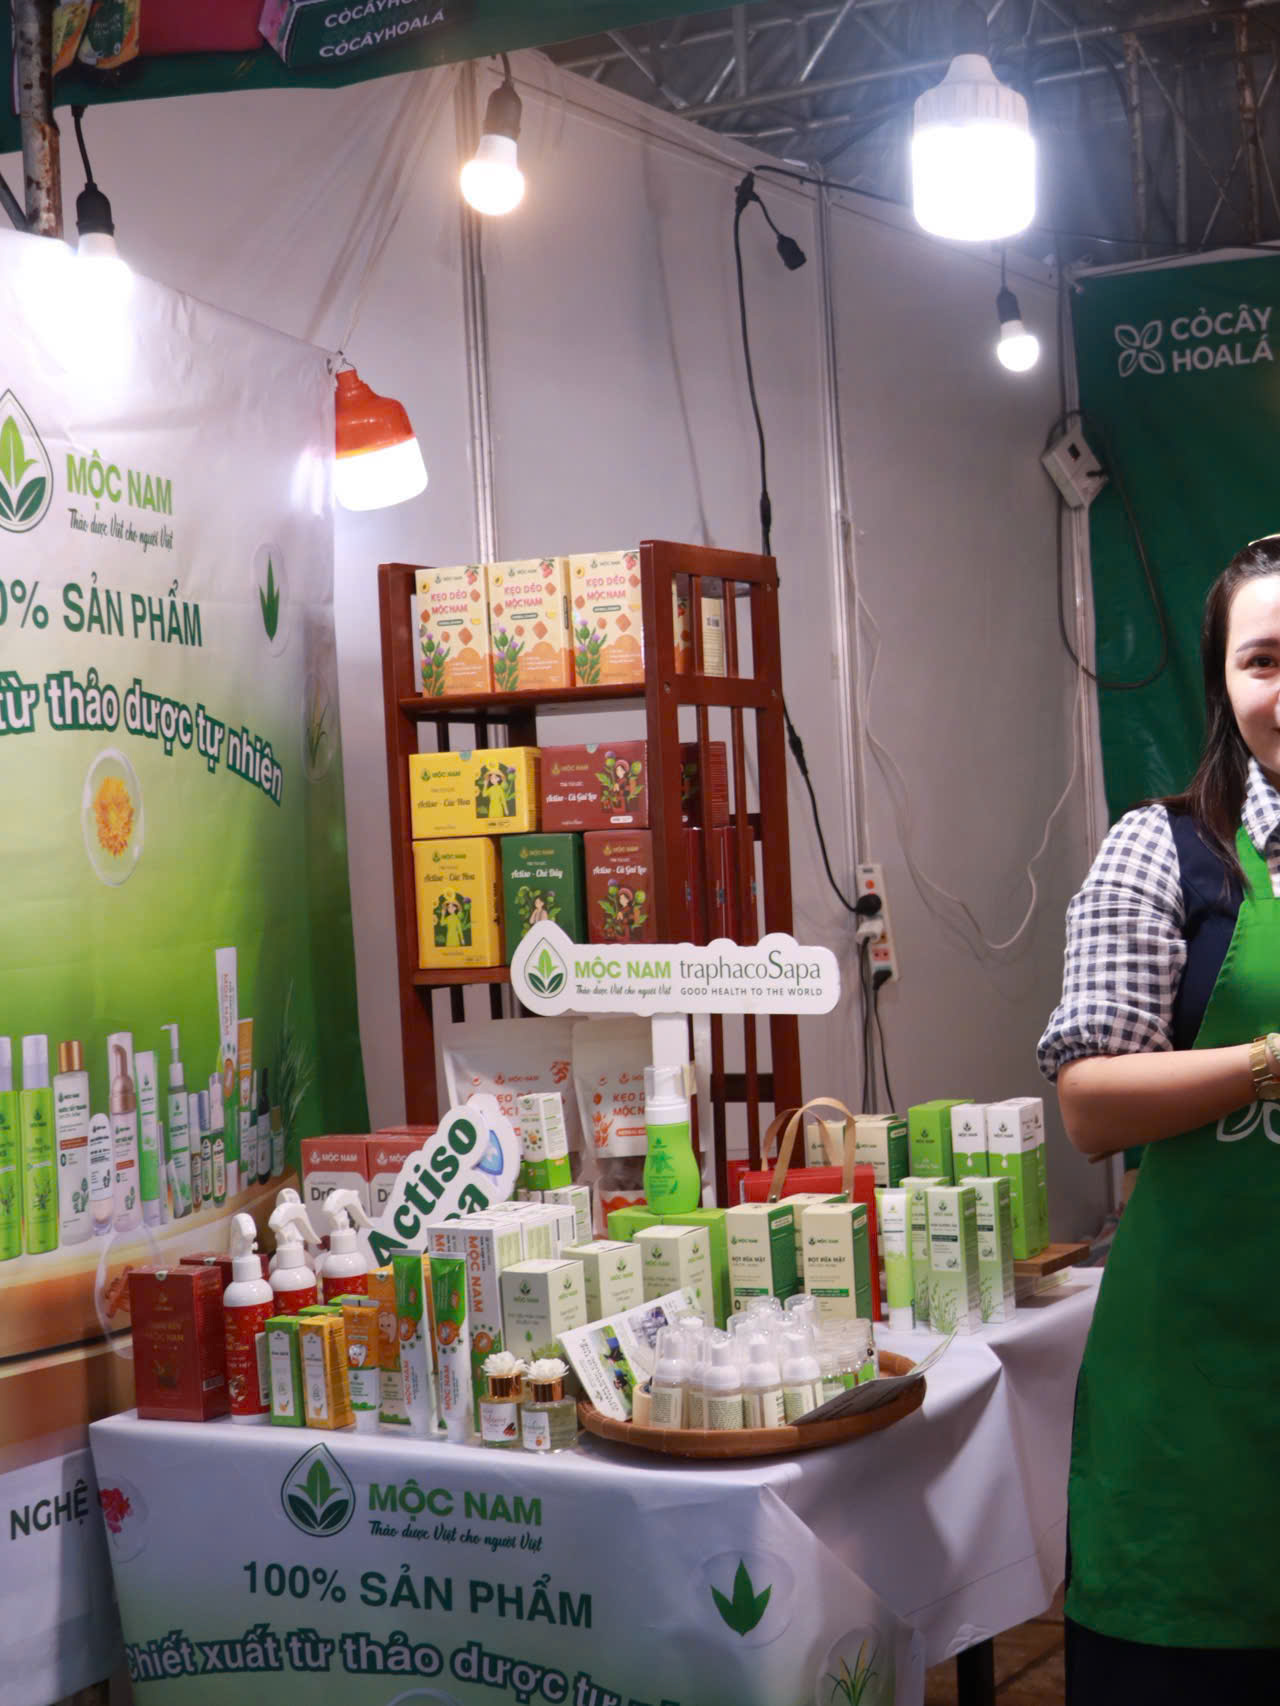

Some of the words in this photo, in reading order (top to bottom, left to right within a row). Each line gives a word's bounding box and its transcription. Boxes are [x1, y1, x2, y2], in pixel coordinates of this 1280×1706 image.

[1171, 306, 1273, 341] CỎCÂY
[1172, 336, 1274, 374] HOALÁ
[67, 448, 122, 511] MỘC
[127, 468, 173, 516] NAM
[62, 571, 124, 637] SẢN
[130, 579, 203, 648] PHẨM
[46, 670, 119, 729] thảo
[125, 681, 192, 753] dược
[197, 706, 225, 771] tự
[227, 729, 283, 804] nhiên
[574, 956, 622, 984] MỘC
[627, 960, 672, 979] NAM
[680, 949, 821, 986] traphacoSapa
[680, 987, 708, 996] GOOD
[711, 987, 747, 996] HEALTH
[751, 987, 763, 996] TO
[767, 987, 784, 996] THE
[788, 987, 823, 996] WORLD
[323, 1152, 341, 1163] MỘC
[341, 1153, 358, 1162] NAM
[367, 1117, 478, 1267] Actiso
[471, 1277, 484, 1313] NAM
[10, 1479, 89, 1541] NGHỆ
[368, 1478, 455, 1522] MỘC
[464, 1491, 543, 1526] NAM
[368, 1519, 399, 1538] Thảo
[401, 1519, 430, 1541] dược
[434, 1522, 458, 1544] Việt
[459, 1526, 481, 1545] cho
[484, 1531, 517, 1553] người
[519, 1532, 544, 1554] Việt
[243, 1561, 347, 1603] 100%
[359, 1563, 454, 1612] SẢN
[468, 1573, 593, 1629] PHẨM
[201, 1625, 281, 1671] xuất
[288, 1631, 334, 1670] từ
[343, 1633, 441, 1673] thảo
[453, 1645, 567, 1701] dược
